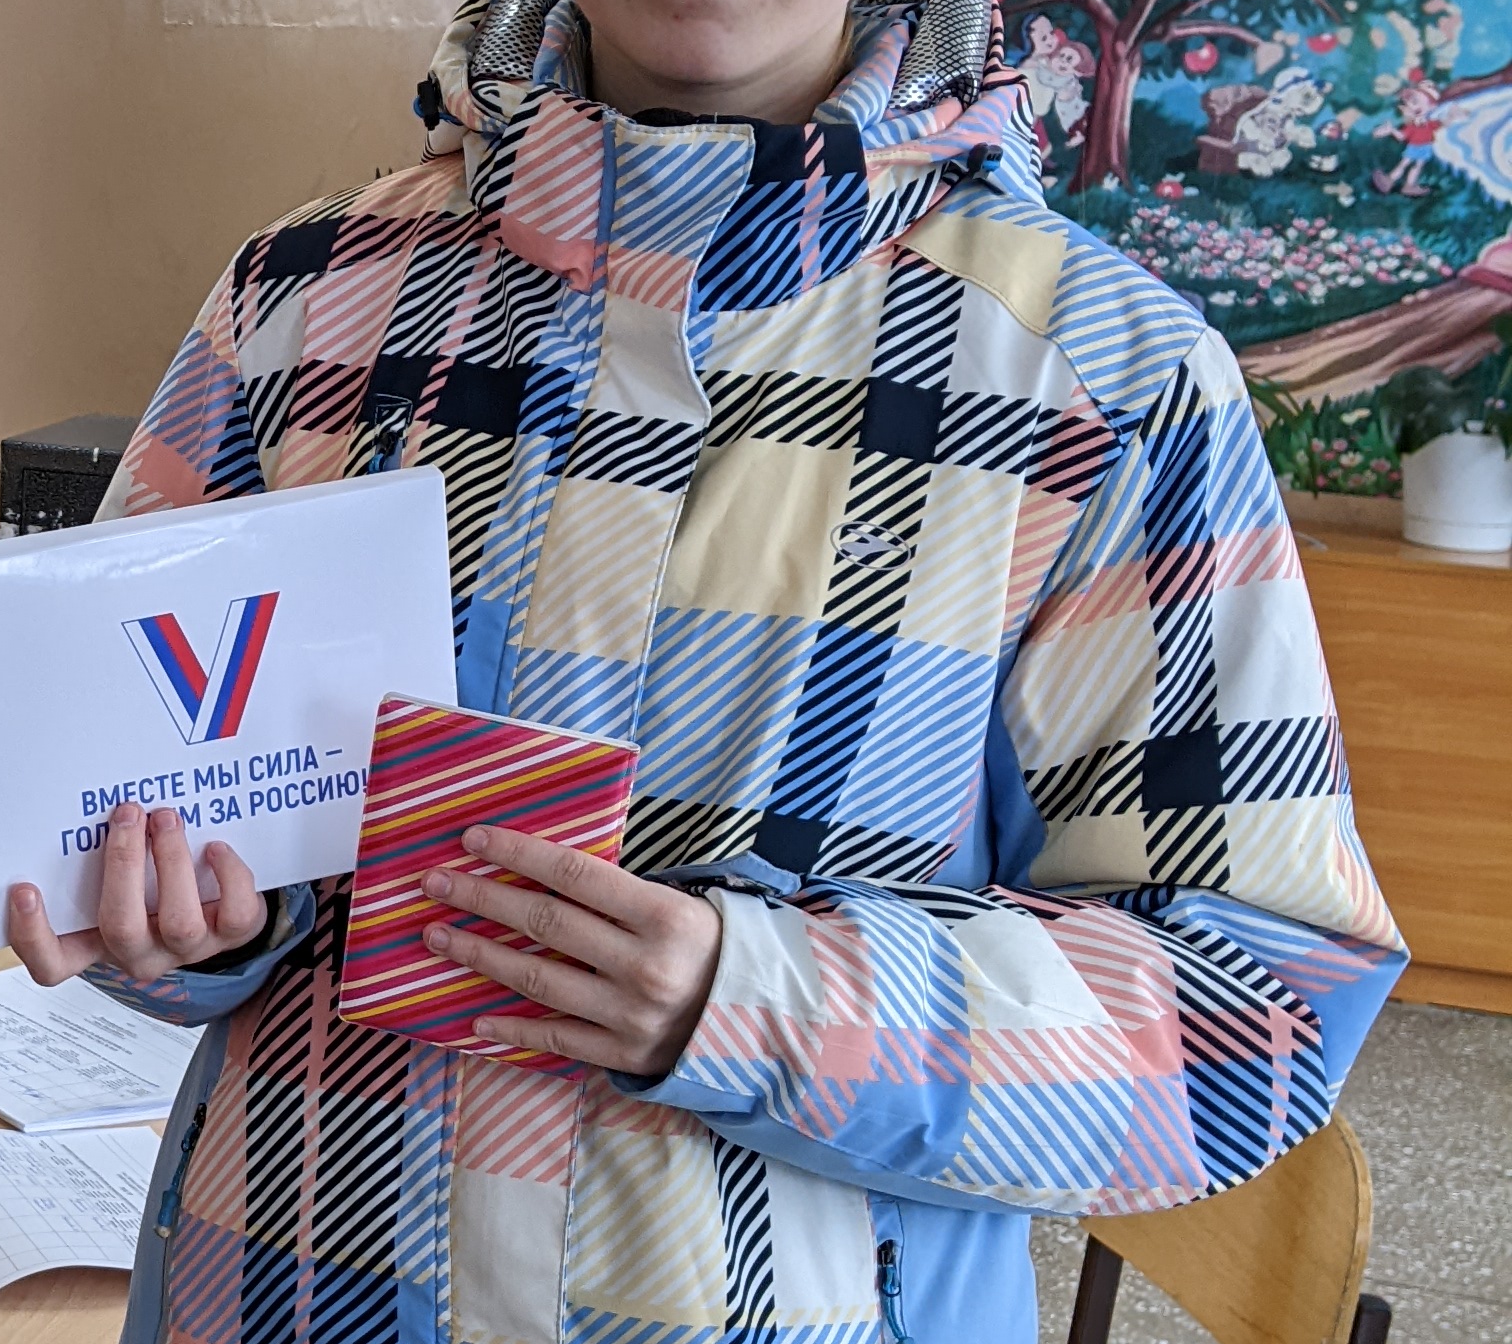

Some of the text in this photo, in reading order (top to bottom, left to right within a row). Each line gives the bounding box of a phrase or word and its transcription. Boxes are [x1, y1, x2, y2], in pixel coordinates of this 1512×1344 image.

[81, 771, 186, 817] ВМЕСТЕ
[193, 760, 240, 793] МЫ
[249, 745, 319, 781] СИЛА
[209, 795, 243, 824] ЗА
[249, 768, 367, 816] РОССИЮ!
